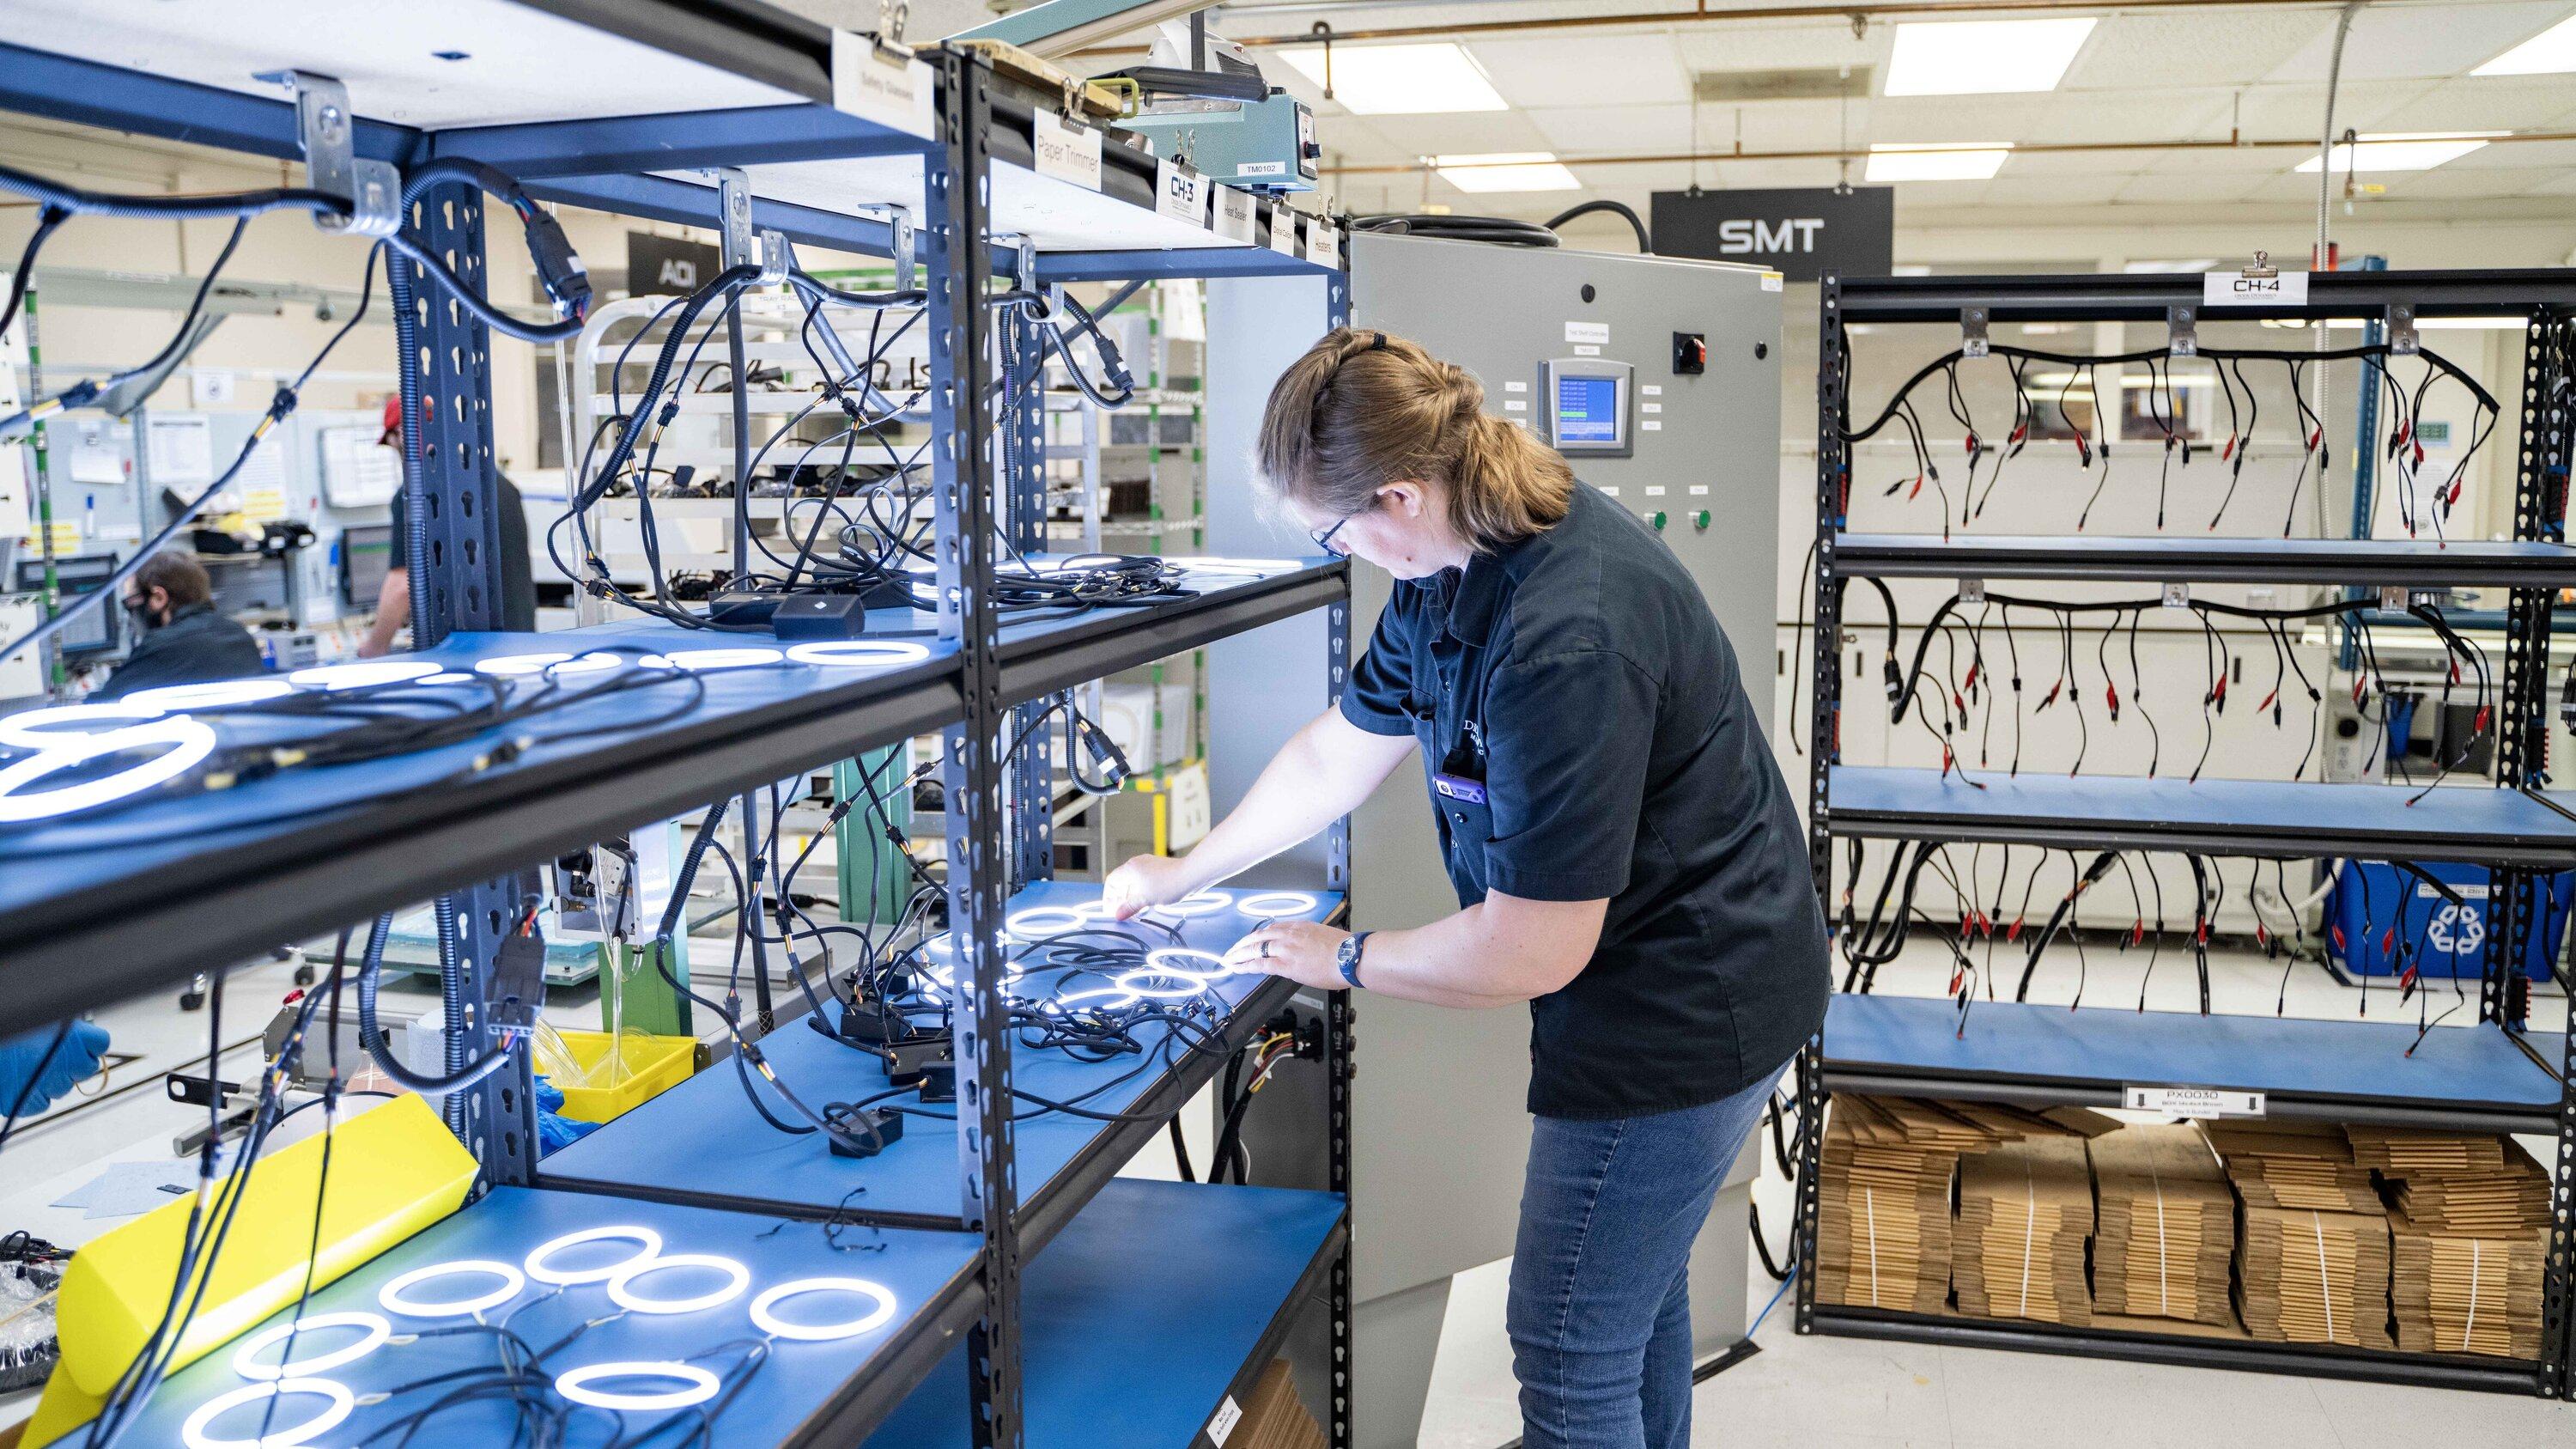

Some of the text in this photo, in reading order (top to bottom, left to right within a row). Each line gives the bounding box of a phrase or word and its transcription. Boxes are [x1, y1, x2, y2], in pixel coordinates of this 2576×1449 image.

[1038, 134, 1099, 173] Paper Trimmer
[1170, 175, 1194, 203] CH-3
[1224, 204, 1247, 222] Heat Sealer
[1315, 236, 1332, 253] Heaters
[1719, 218, 1825, 254] SMT
[658, 258, 696, 289] AOI
[2233, 280, 2280, 292] CH-4
[2166, 1090, 2219, 1099] PX0030
